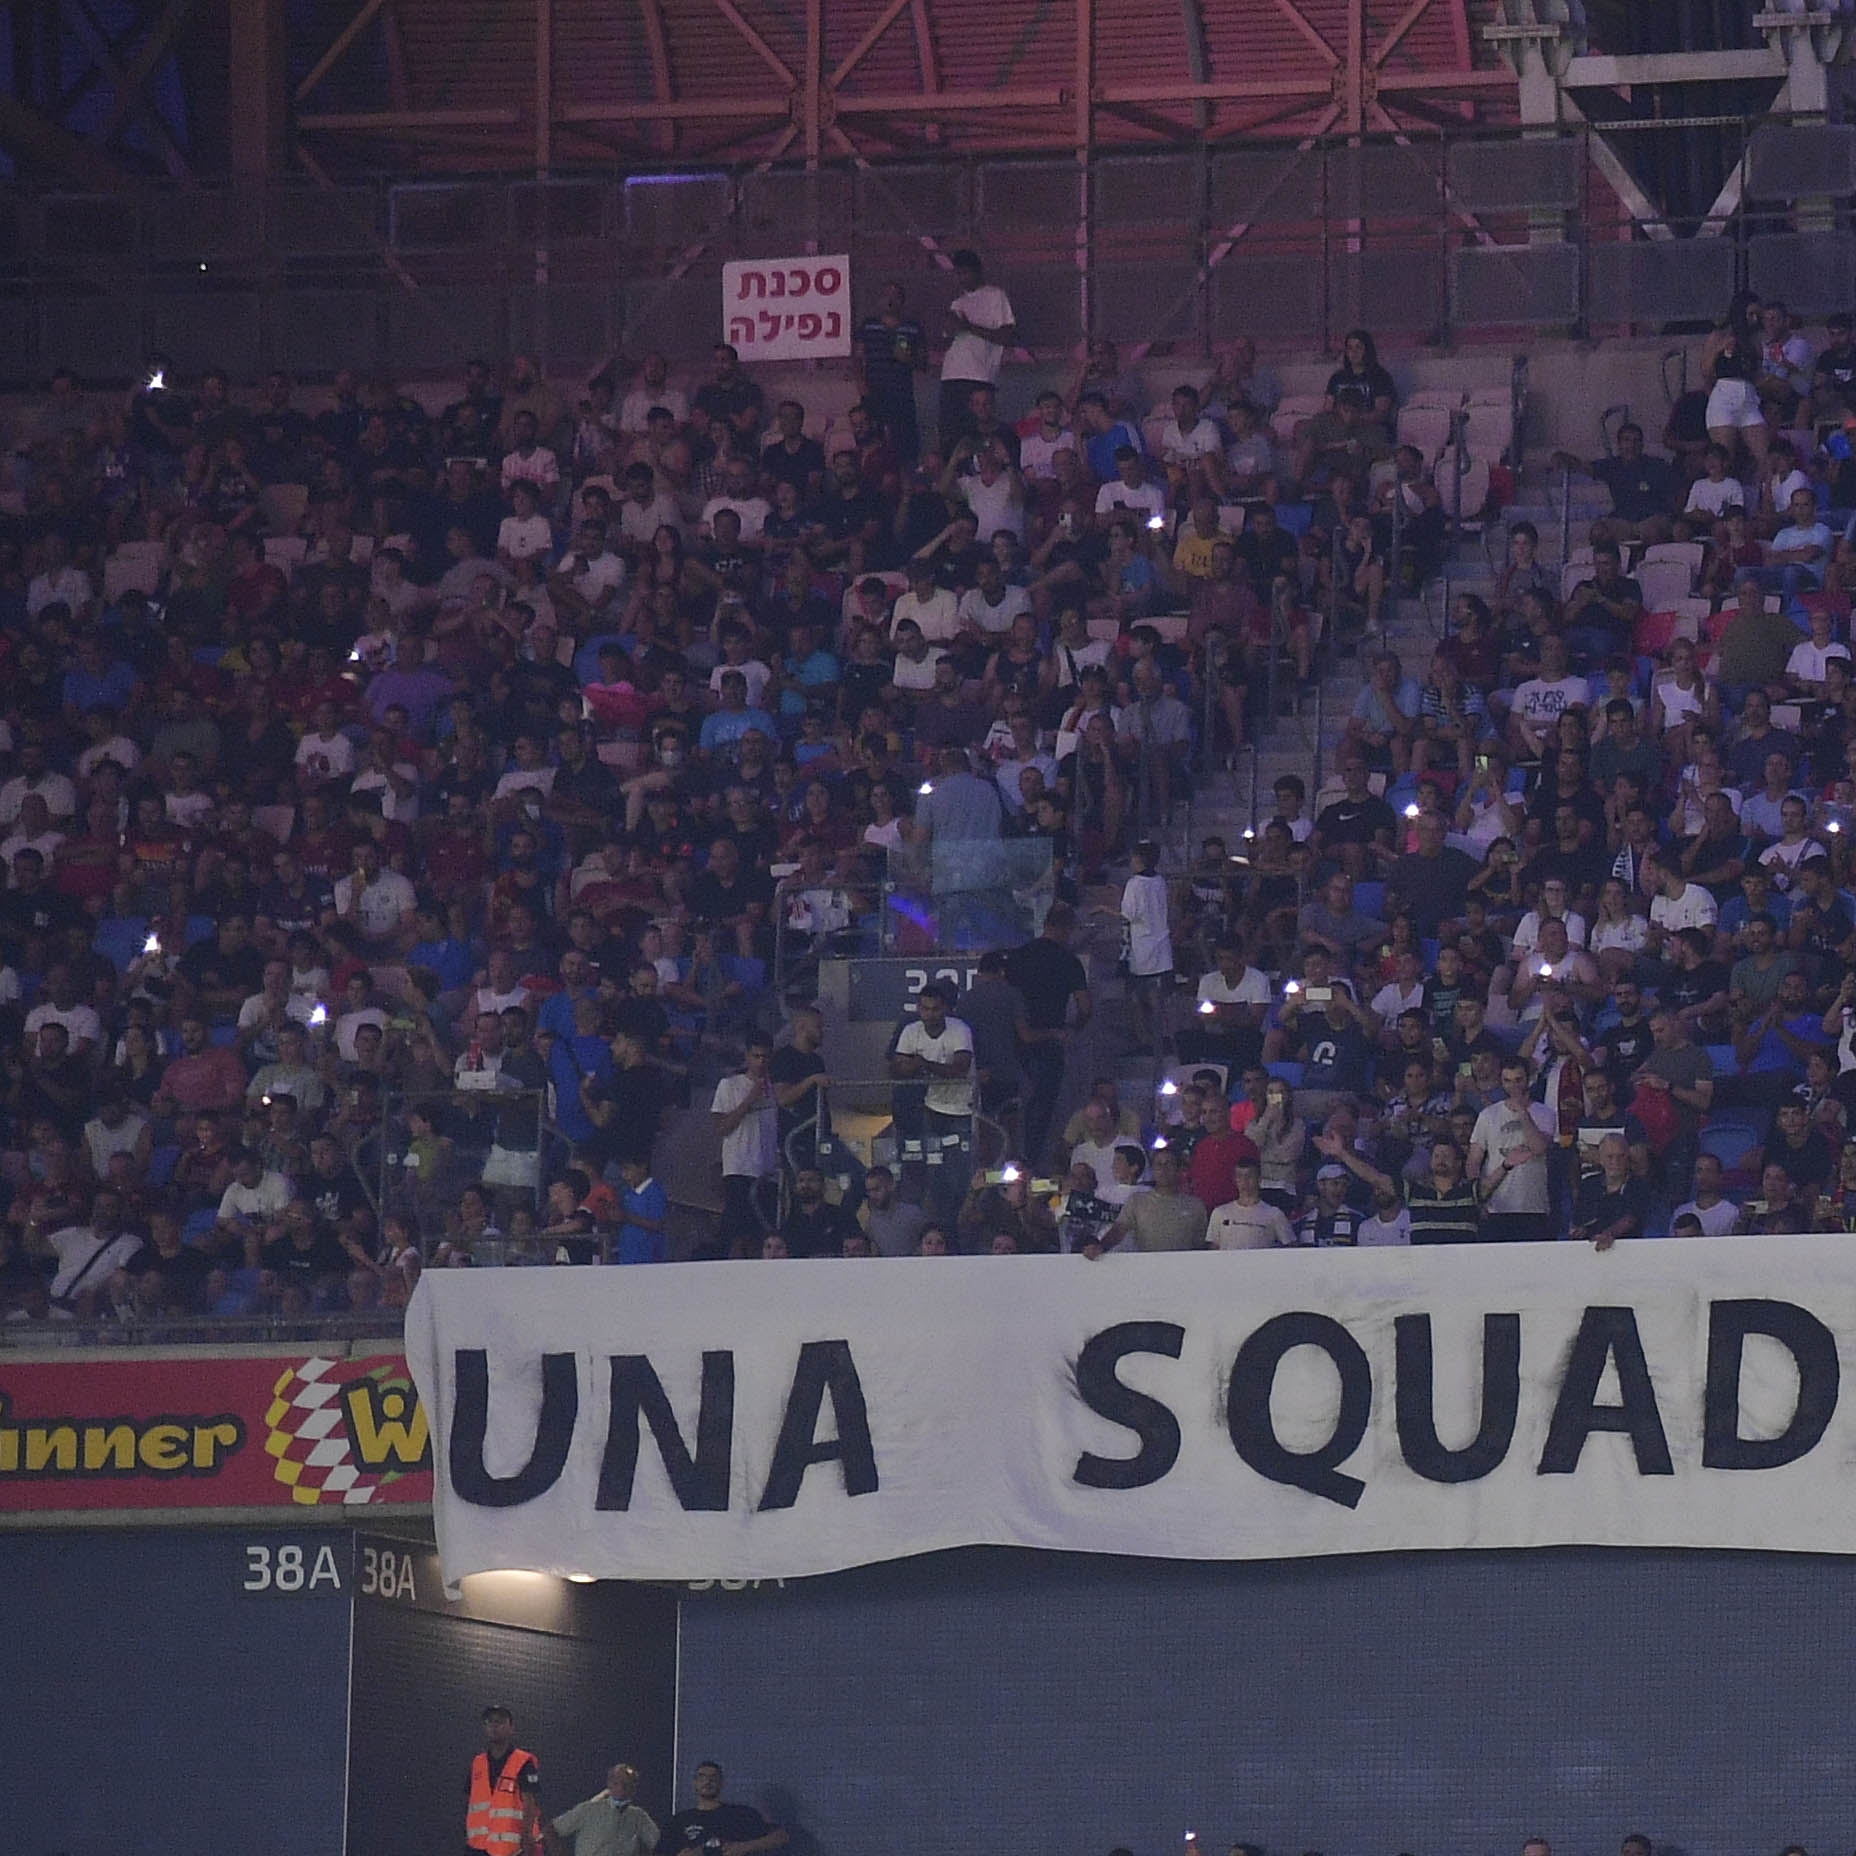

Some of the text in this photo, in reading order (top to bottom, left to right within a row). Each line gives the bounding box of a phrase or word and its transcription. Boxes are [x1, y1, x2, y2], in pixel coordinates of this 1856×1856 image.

[736, 268, 842, 301] סכנת
[730, 310, 842, 345] נפילה
[0, 1421, 237, 1472] inner
[449, 1338, 883, 1514] UNA
[243, 1545, 342, 1593] 38A
[360, 1547, 416, 1602] 38A
